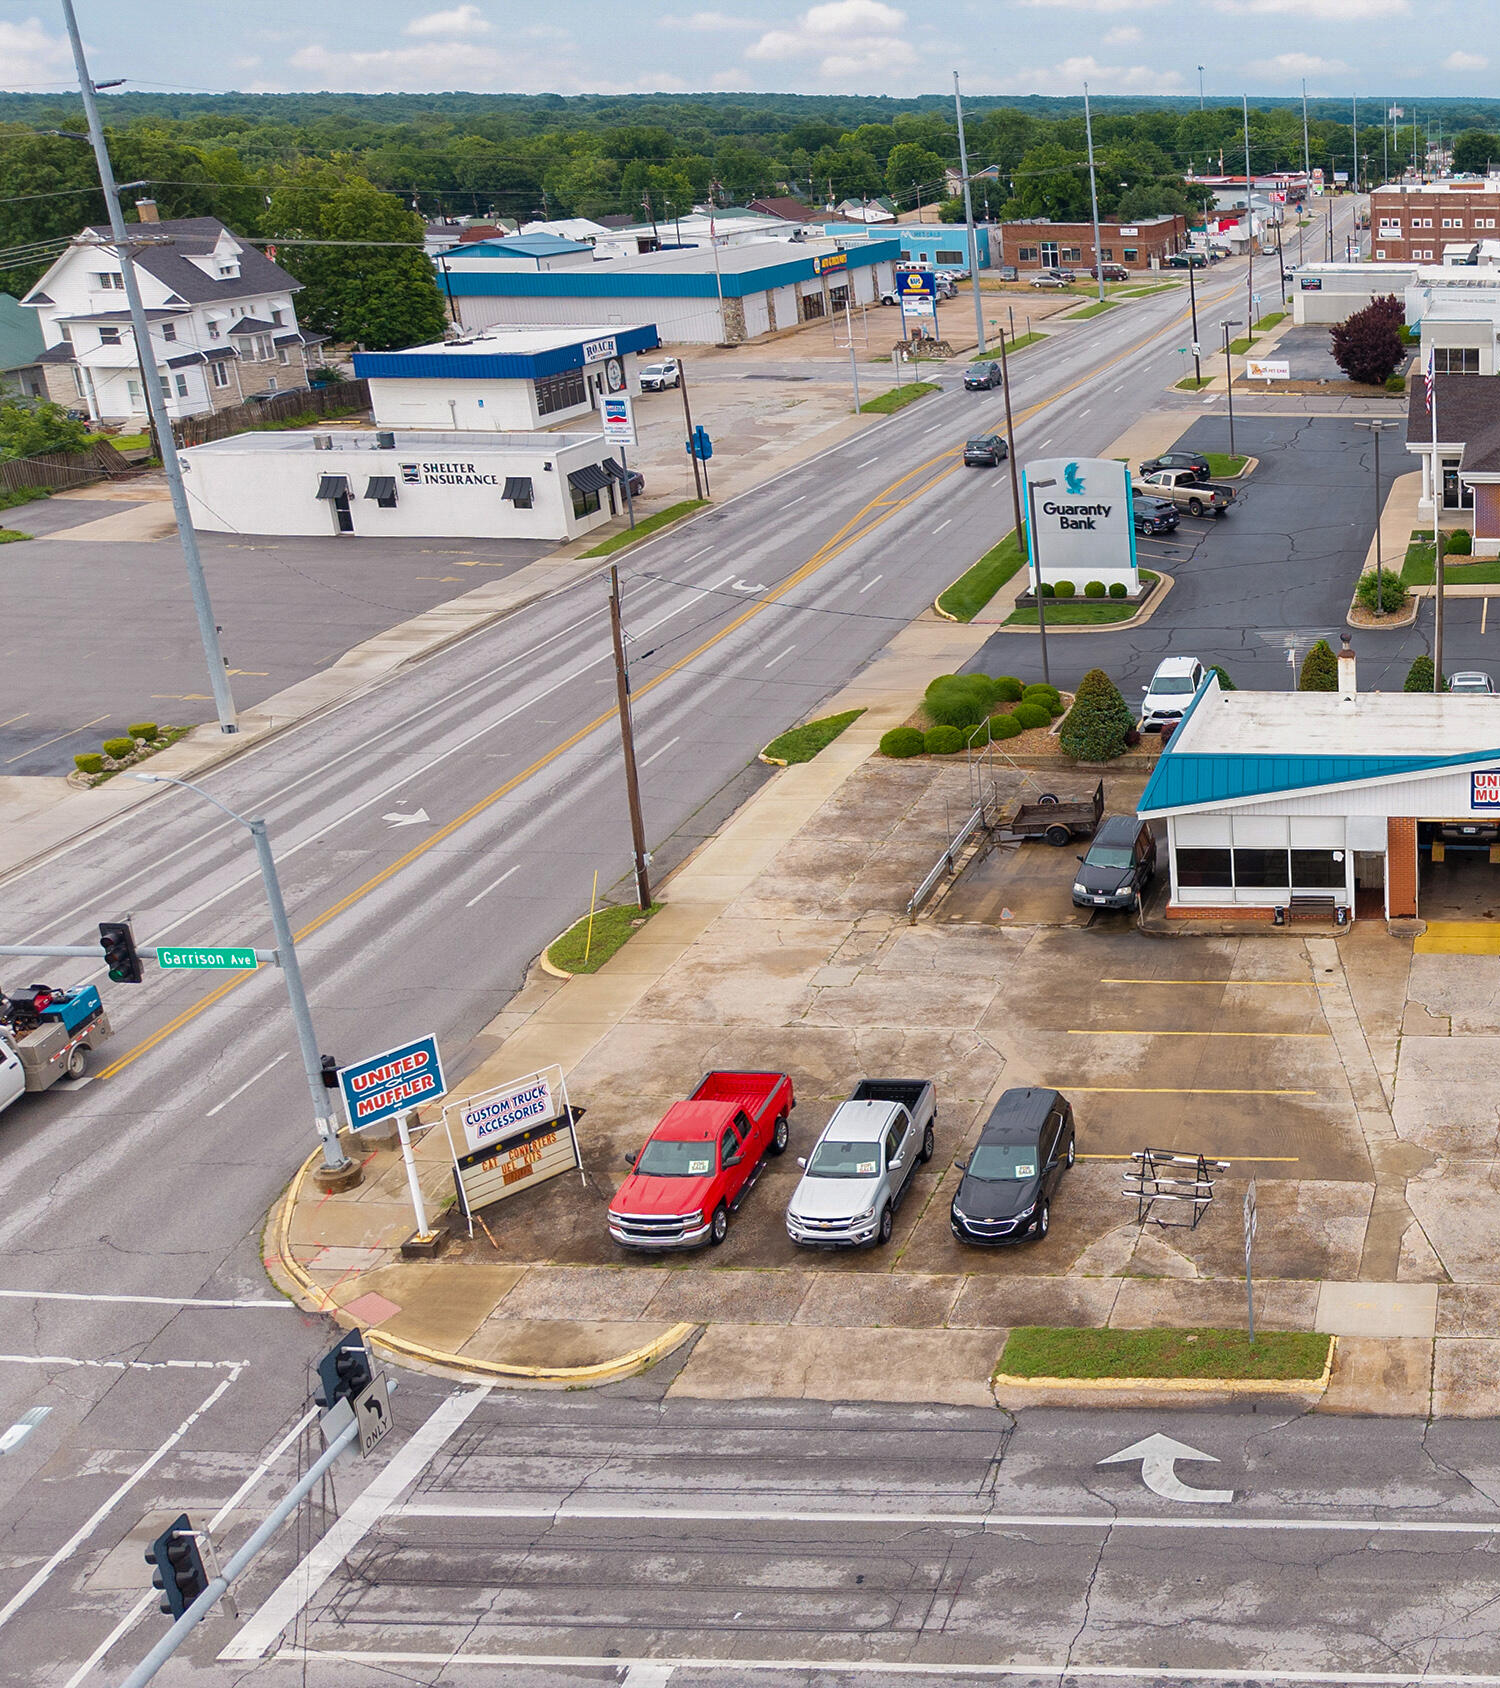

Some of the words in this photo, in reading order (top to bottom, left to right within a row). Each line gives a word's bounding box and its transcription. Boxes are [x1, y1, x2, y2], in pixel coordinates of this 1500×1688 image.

[586, 341, 614, 357] ROACH
[423, 463, 476, 473] SHELTER
[424, 474, 499, 485] INSURANCE
[1043, 502, 1112, 518] Guaranty
[1060, 516, 1097, 529] Bank
[163, 951, 225, 965] Garrison
[231, 954, 251, 965] Ave
[352, 1051, 430, 1092] UNITED
[357, 1074, 435, 1117] MUFFLER
[466, 1100, 511, 1126] CUSTOM
[512, 1085, 548, 1107] TRUCK
[478, 1101, 545, 1138] ACCESSORIES
[481, 1156, 498, 1172] CAT
[508, 1132, 557, 1160] CONVERTERS
[524, 1150, 542, 1165] KITS
[366, 1416, 387, 1449] ONLY
